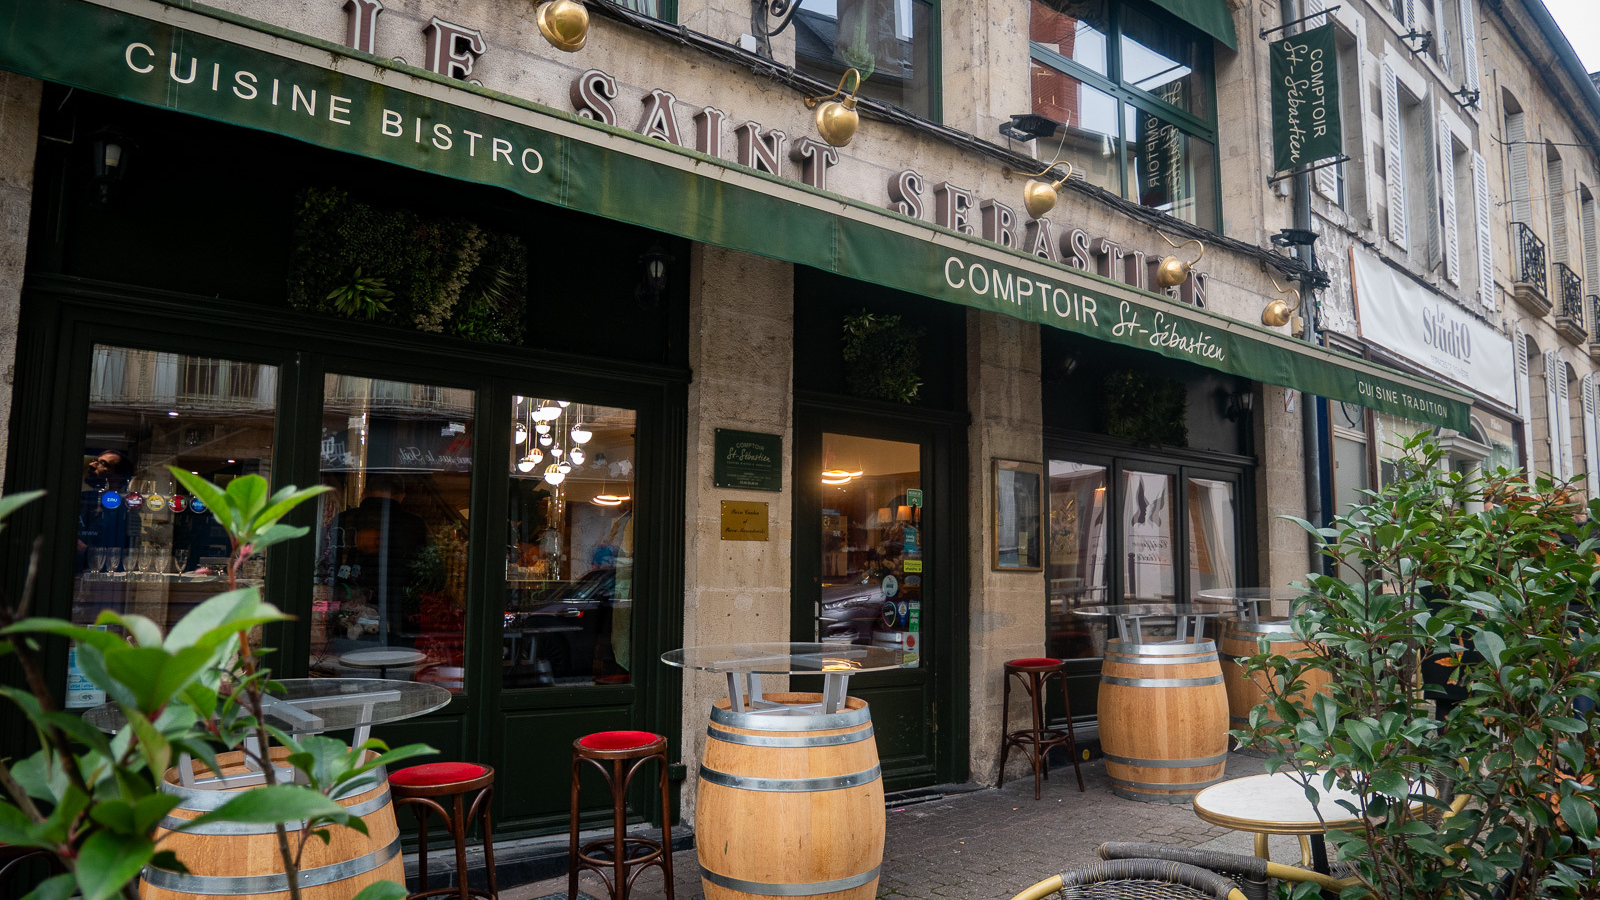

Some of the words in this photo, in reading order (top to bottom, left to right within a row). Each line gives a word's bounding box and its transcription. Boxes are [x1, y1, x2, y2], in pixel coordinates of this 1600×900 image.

[125, 42, 352, 126] CUISINE
[381, 109, 544, 174] BISTRO
[570, 68, 839, 191] SAINT
[1283, 40, 1309, 164] St-Sébastien
[1309, 48, 1327, 139] COMPTOIR
[944, 256, 1099, 327] COMPTOIR
[1112, 301, 1225, 362] St-Sébastien
[736, 443, 765, 451] COMPTOIR
[1358, 380, 1398, 405] CUISINE
[1401, 394, 1448, 419] TRADITION
